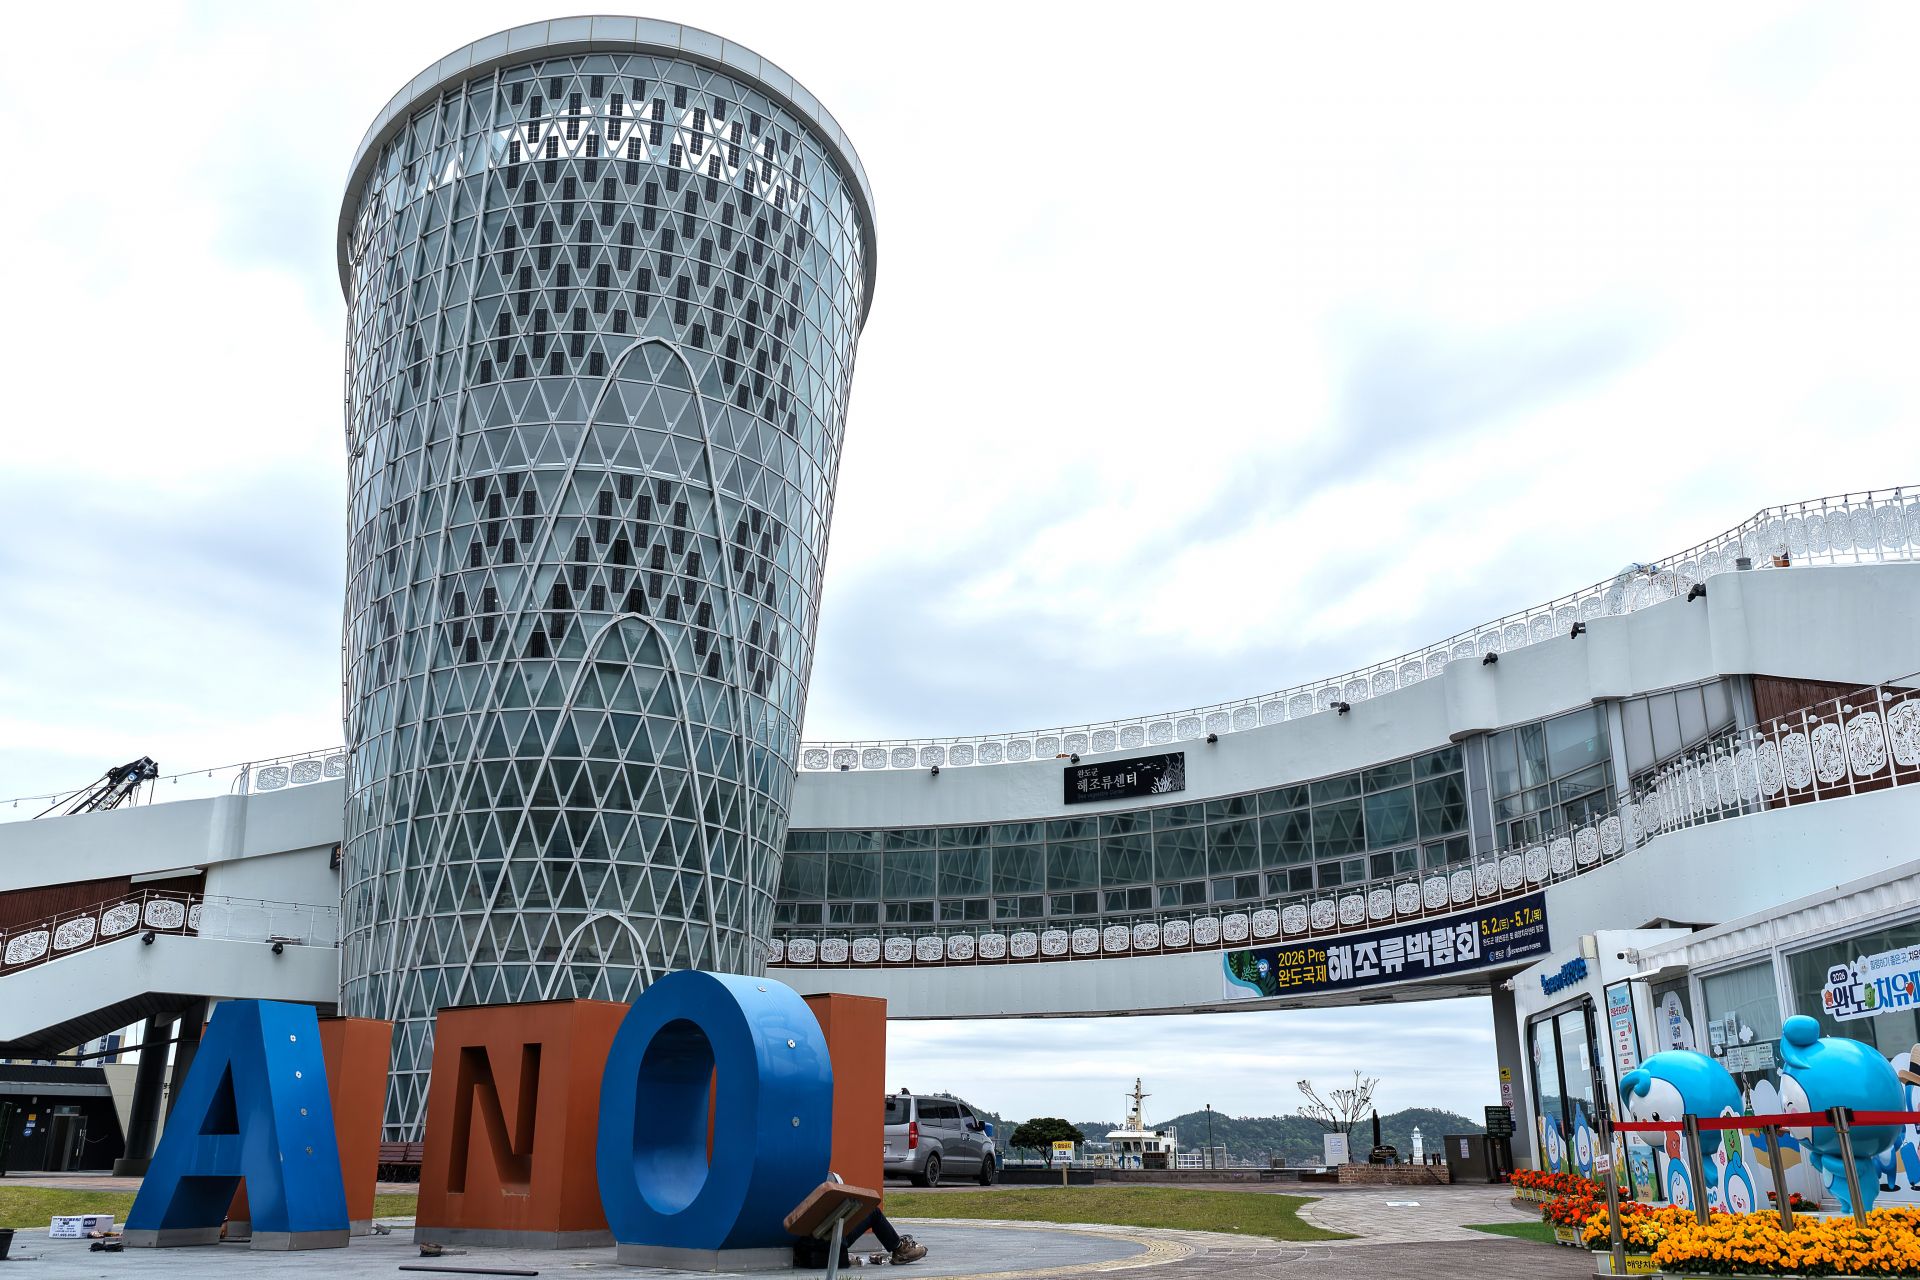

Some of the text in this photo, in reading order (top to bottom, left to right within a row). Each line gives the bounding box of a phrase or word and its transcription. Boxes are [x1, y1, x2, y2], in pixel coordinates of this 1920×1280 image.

[1076, 771, 1137, 792] 해조류센터
[1077, 768, 1099, 778] 완도군
[1278, 948, 1326, 967] 2026 Pre
[1326, 921, 1481, 982] 해조류박람회
[1278, 965, 1327, 988] 완도국제
[1832, 973, 1846, 982] 2026
